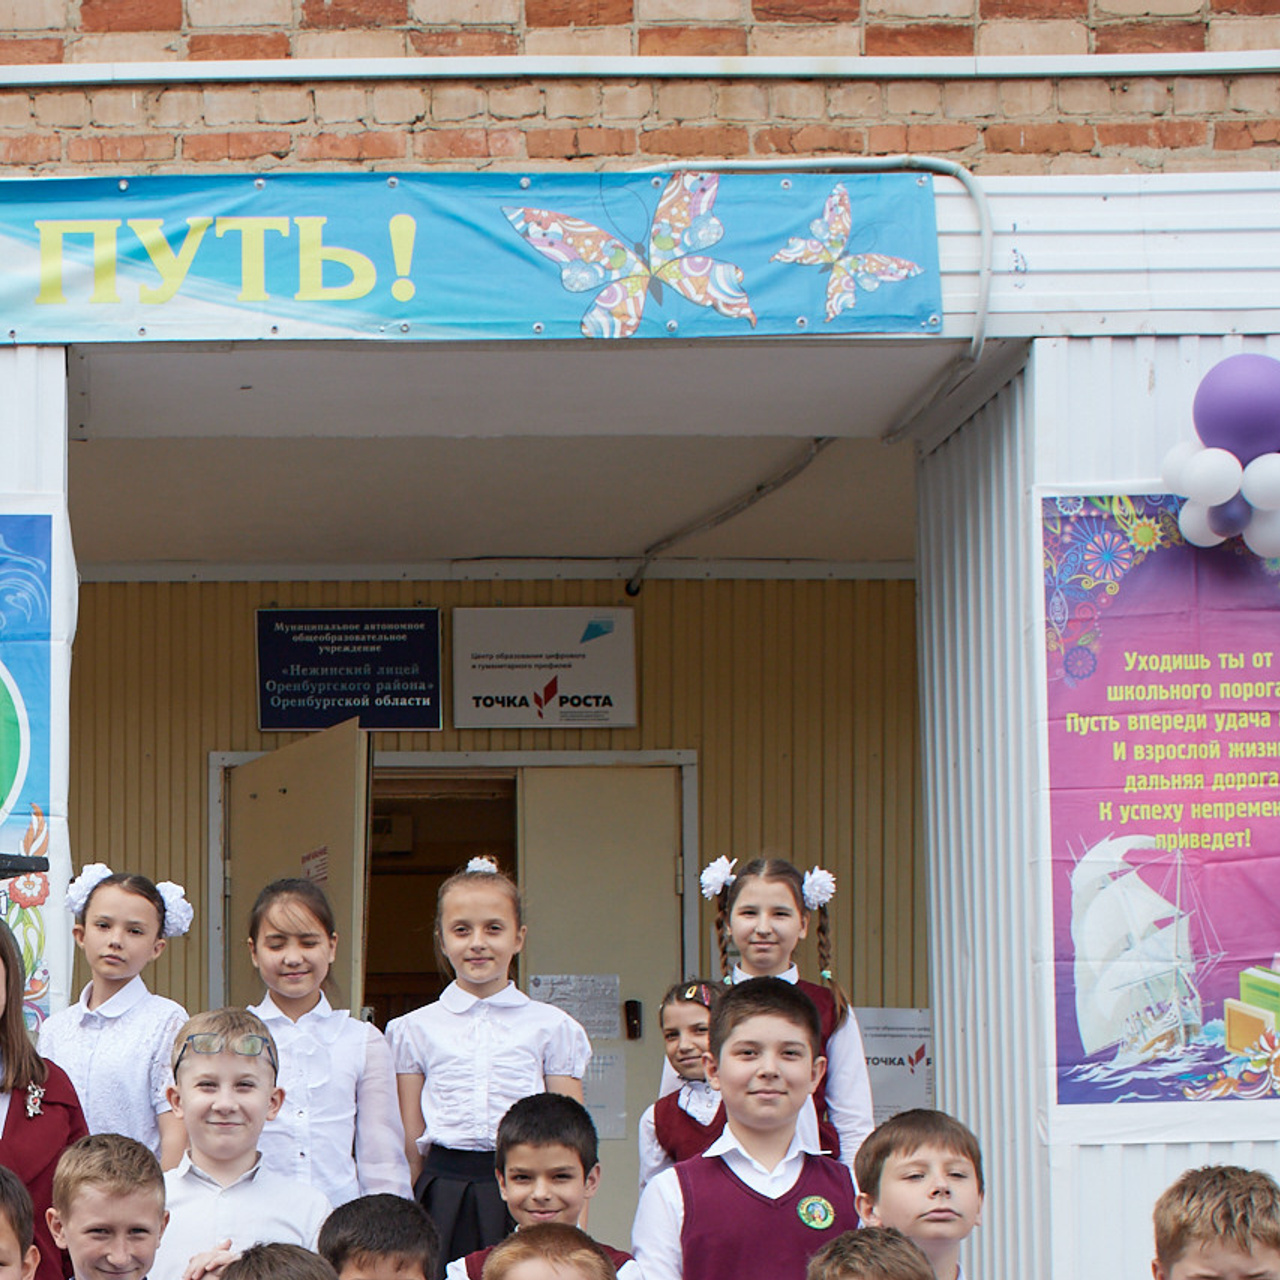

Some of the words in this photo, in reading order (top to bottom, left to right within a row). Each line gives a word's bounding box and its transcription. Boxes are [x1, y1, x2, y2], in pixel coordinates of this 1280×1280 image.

[34, 213, 418, 305] ПУТЬ!
[274, 622, 359, 633] Муниципальное
[363, 623, 425, 631] автономное
[292, 633, 407, 644] общеобразовательное
[318, 644, 382, 655] учреждение
[376, 663, 420, 677] лицей
[1124, 651, 1211, 673] Уходишь
[1218, 653, 1245, 669] ты
[1252, 652, 1274, 668] от
[265, 680, 371, 694] Оренбургского
[1107, 683, 1212, 702] школьного
[270, 694, 370, 709] Оренбургской
[375, 695, 431, 707] области
[472, 696, 530, 708] ТОЧКА
[559, 695, 613, 708] РОСТА
[1066, 713, 1120, 736] Пусть
[1127, 713, 1207, 733] впереди
[1214, 711, 1271, 733] удача
[1113, 741, 1126, 761] И
[1133, 740, 1220, 763] взрослой
[1228, 741, 1280, 759] жизн
[1124, 773, 1205, 793] дальняя
[1211, 771, 1279, 792] дорога
[1099, 801, 1112, 821] К
[1119, 803, 1184, 824] успеху
[1155, 828, 1251, 852] приведет!
[865, 1056, 905, 1066] ТОЧКА
